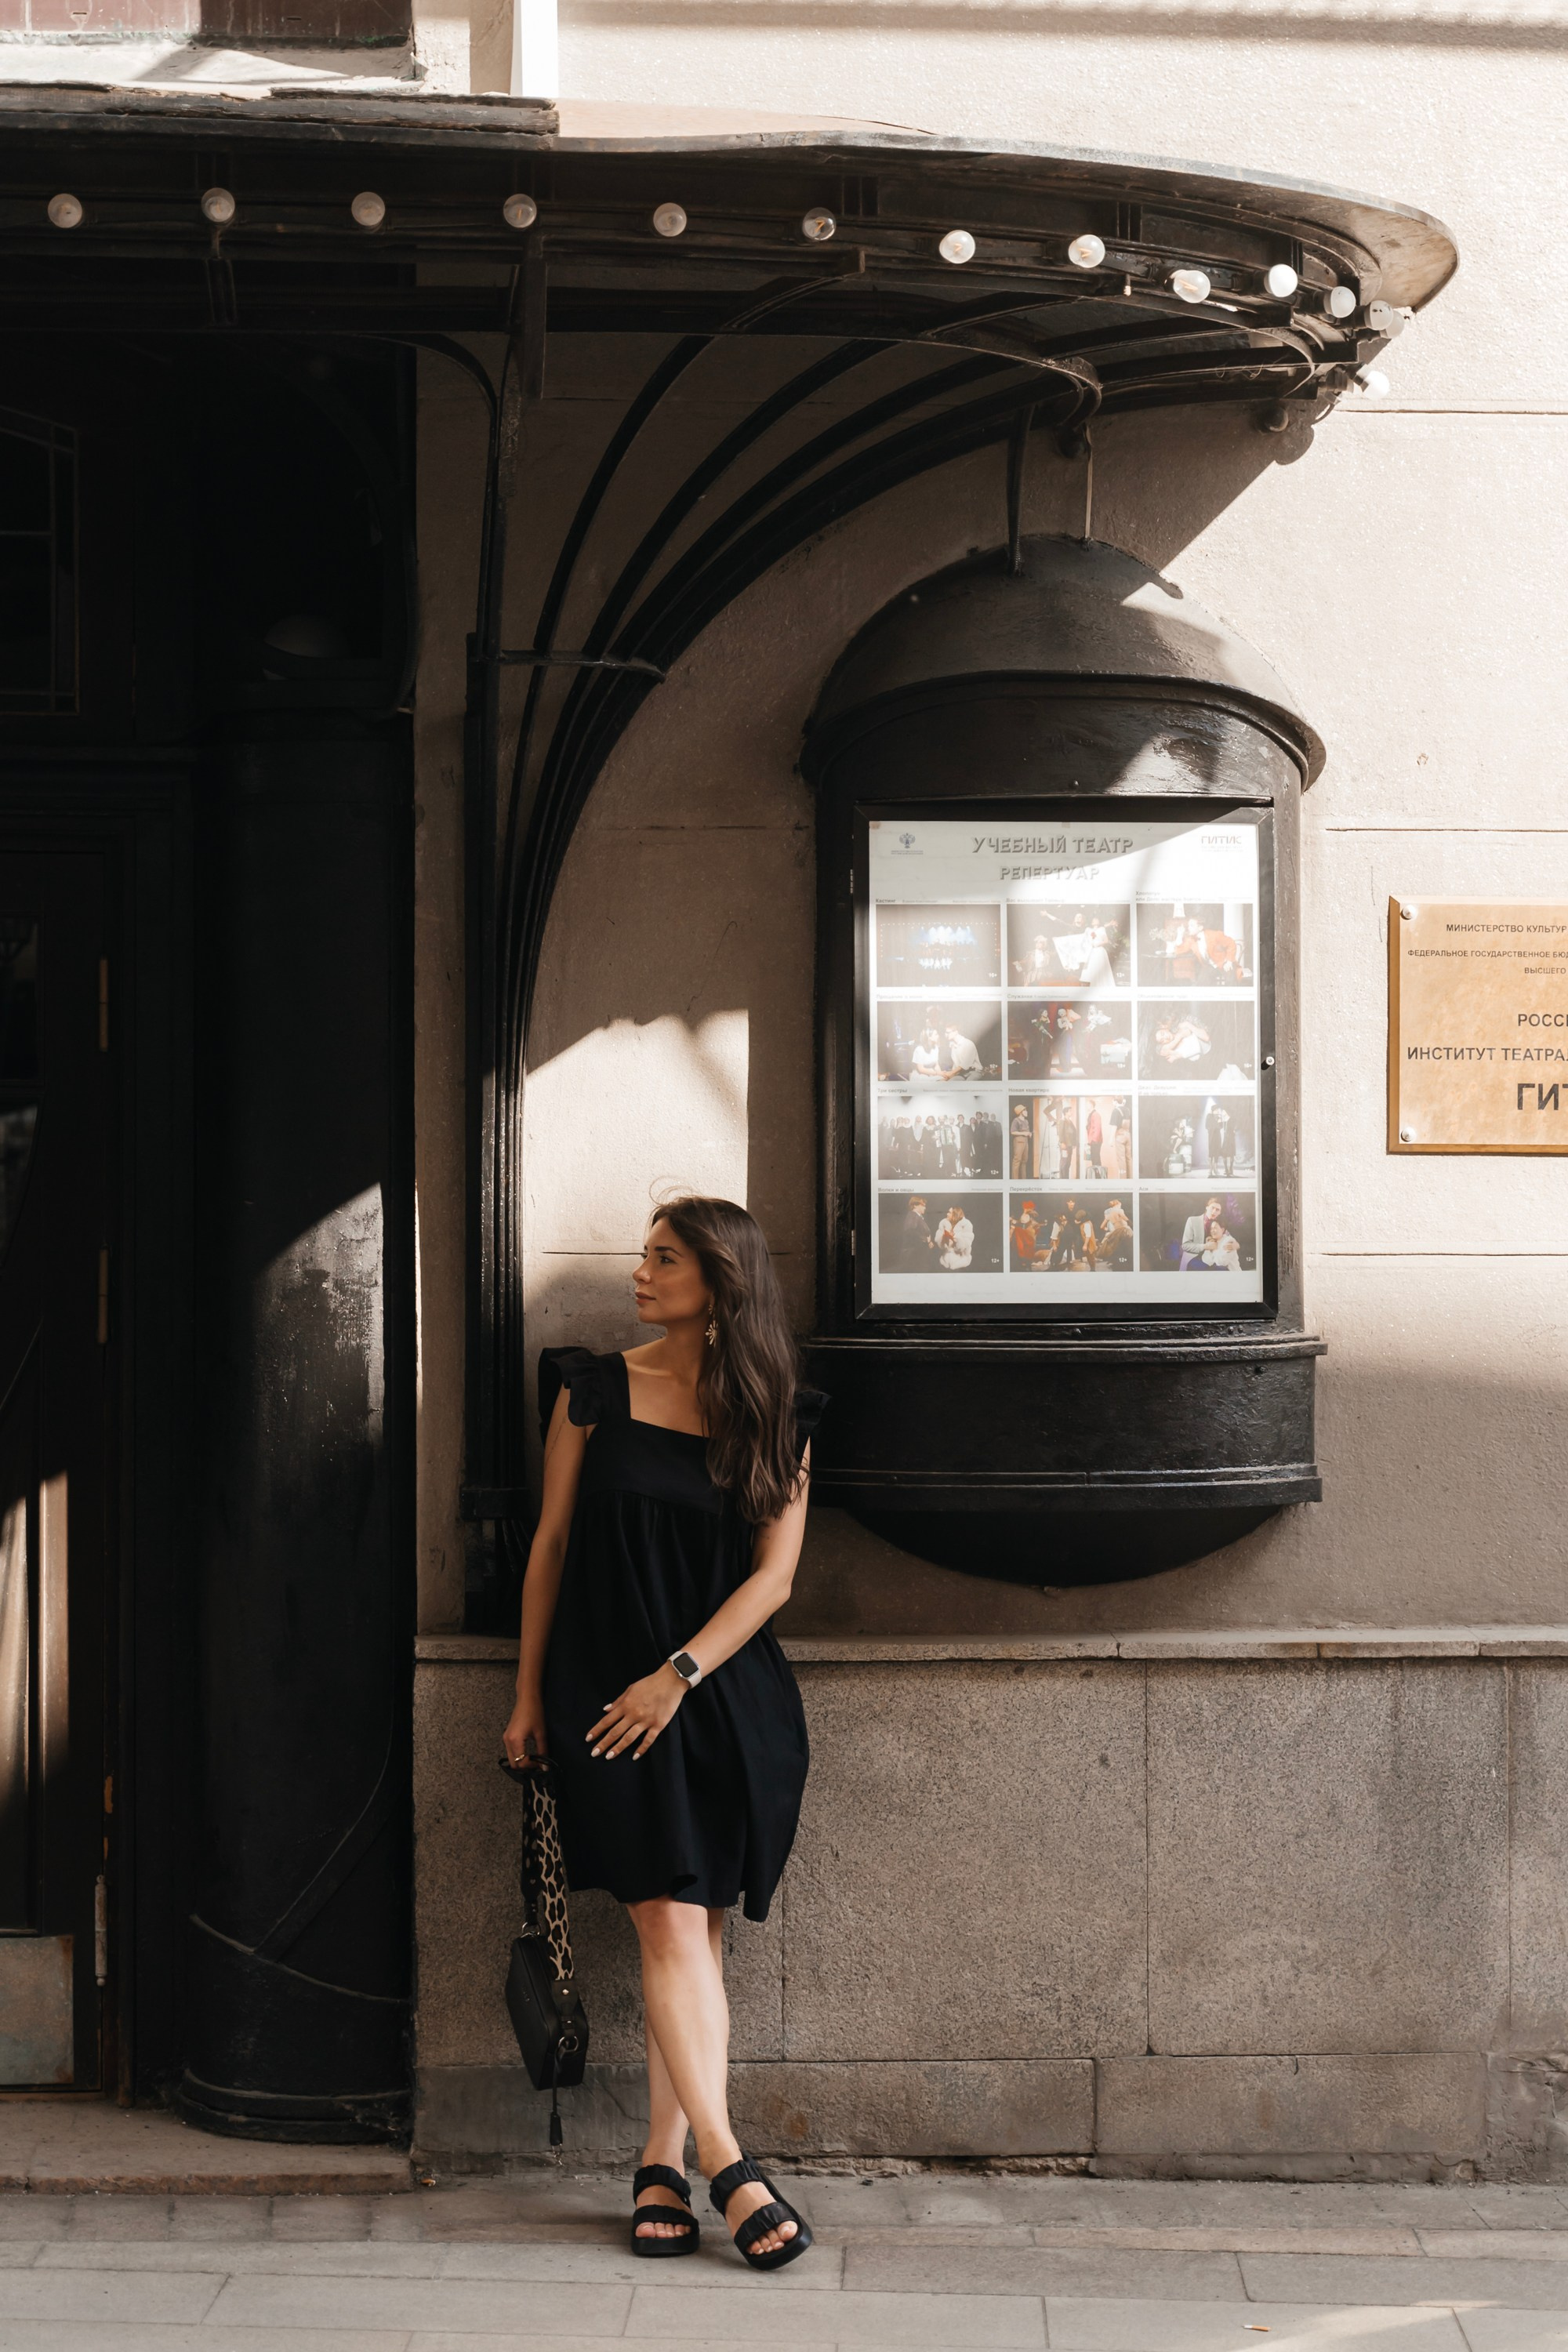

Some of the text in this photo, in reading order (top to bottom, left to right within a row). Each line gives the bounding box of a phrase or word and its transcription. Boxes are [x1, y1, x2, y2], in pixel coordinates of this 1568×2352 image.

[971, 835, 1134, 854] УЧЕБНЫЙ ТЕАТР
[1000, 866, 1099, 880] РЕПЕРТУАР
[1446, 924, 1524, 933] МИНИСТЕРСТВО
[1471, 950, 1550, 959] ГОСУДАРСТВЕННОЕ
[1517, 1014, 1568, 1027] РОСС
[1407, 1047, 1568, 1062] ИНСТИТУТ ТЕАТРА
[1518, 1083, 1568, 1110] ГИ
